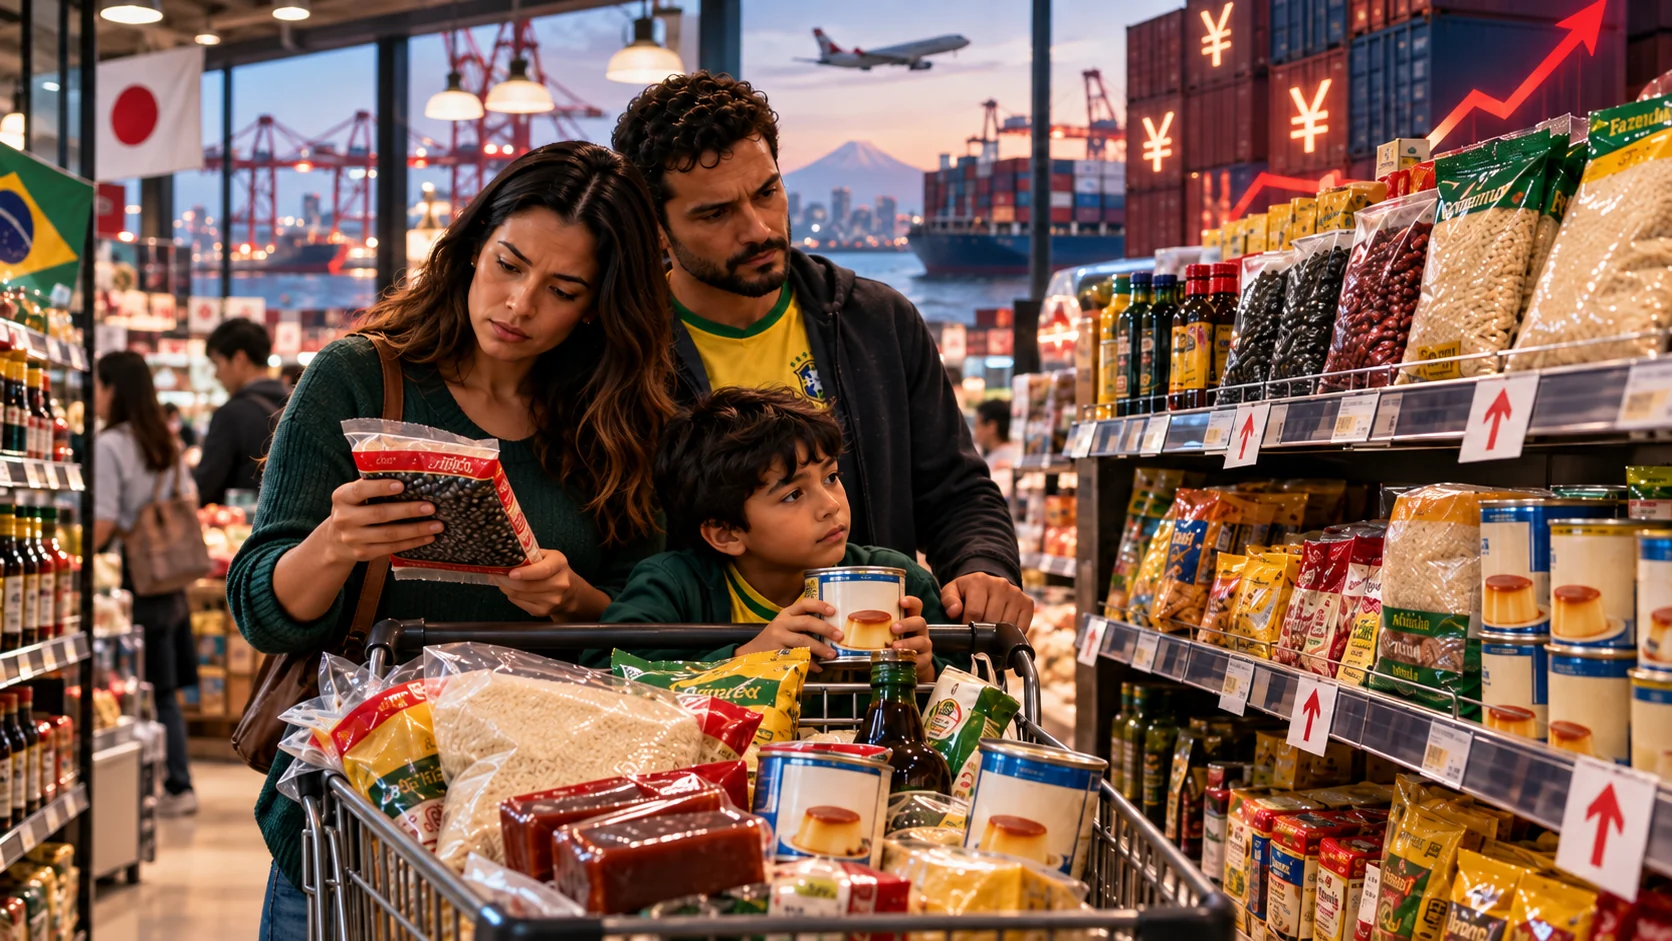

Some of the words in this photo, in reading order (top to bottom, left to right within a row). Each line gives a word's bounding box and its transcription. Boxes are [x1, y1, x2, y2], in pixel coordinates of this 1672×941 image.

[1200, 2, 1234, 67] ¥
[1142, 111, 1174, 172] ¥
[1289, 78, 1332, 153] ¥
